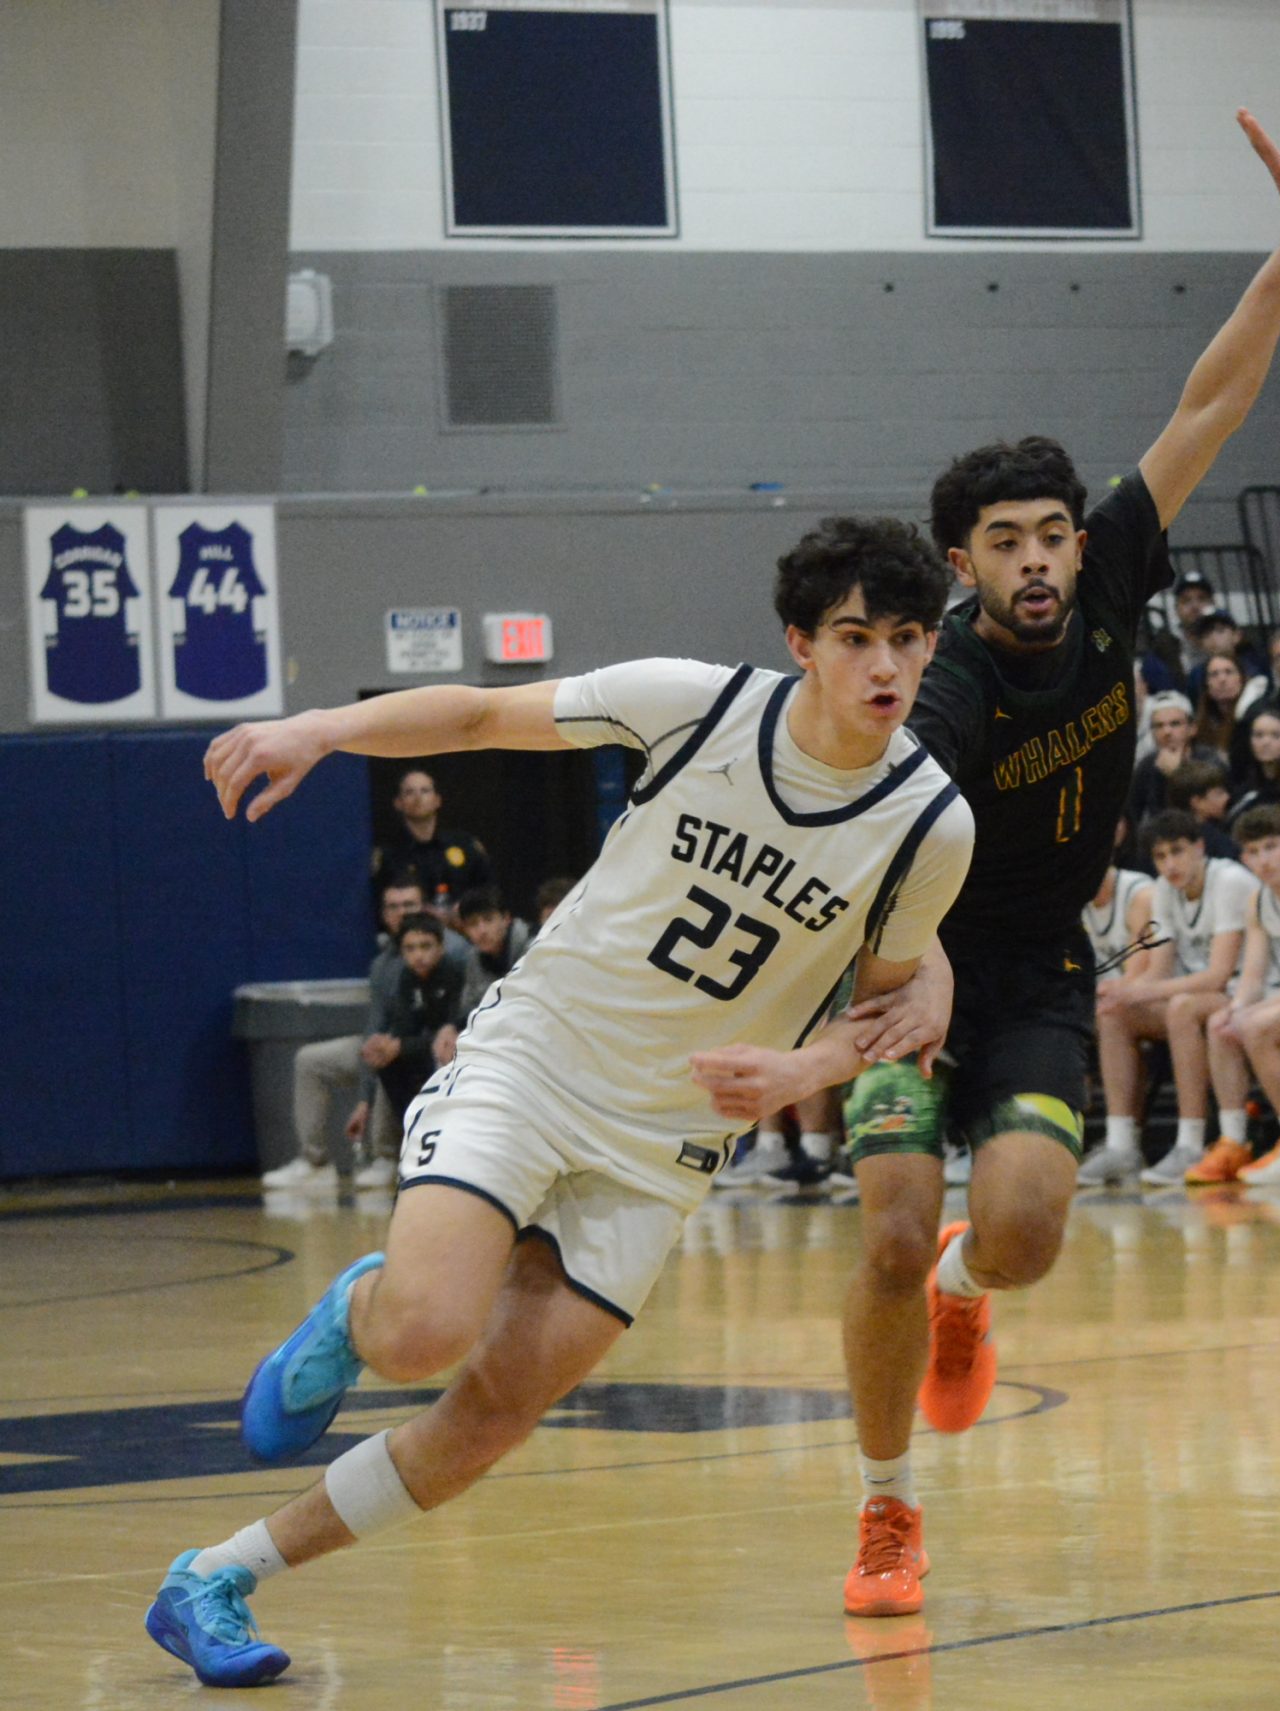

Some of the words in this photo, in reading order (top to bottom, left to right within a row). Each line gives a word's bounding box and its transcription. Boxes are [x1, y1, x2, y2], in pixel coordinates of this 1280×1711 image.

[63, 570, 119, 617] 35
[188, 567, 249, 614] 44
[503, 619, 544, 660] EXIT
[993, 681, 1129, 790] WHALERS
[671, 813, 849, 932] STAPLES
[647, 884, 781, 1001] 23
[418, 1129, 442, 1167] S
